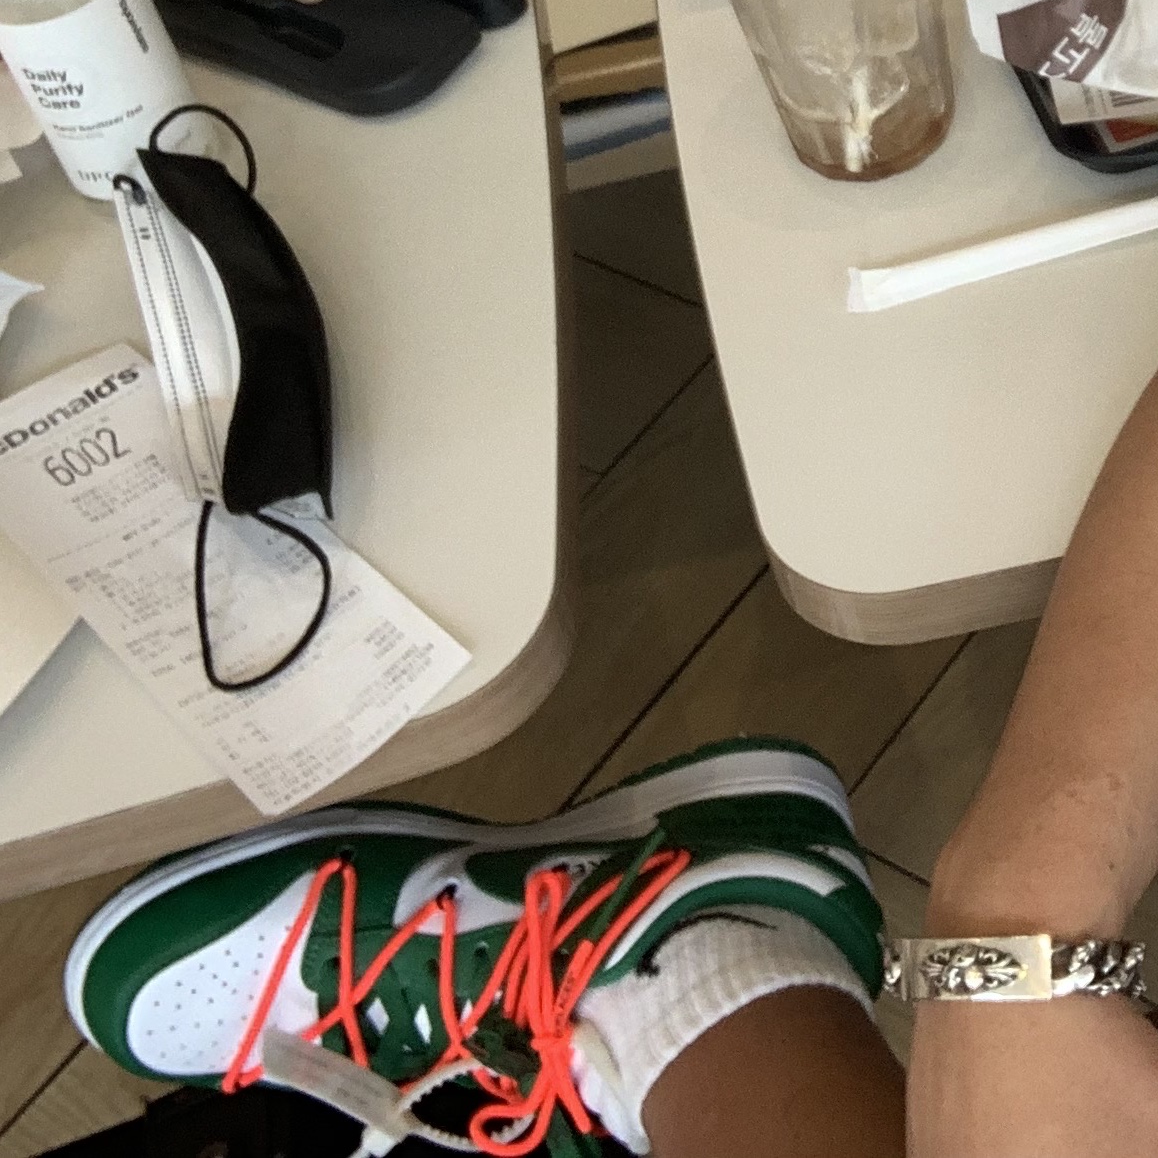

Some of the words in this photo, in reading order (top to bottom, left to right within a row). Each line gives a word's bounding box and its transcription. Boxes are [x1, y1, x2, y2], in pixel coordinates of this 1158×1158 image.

[22, 68, 67, 83] Daily
[30, 82, 84, 97] Purify
[38, 96, 82, 110] Care
[0, 364, 140, 455] Donald's
[43, 427, 131, 487] 6002
